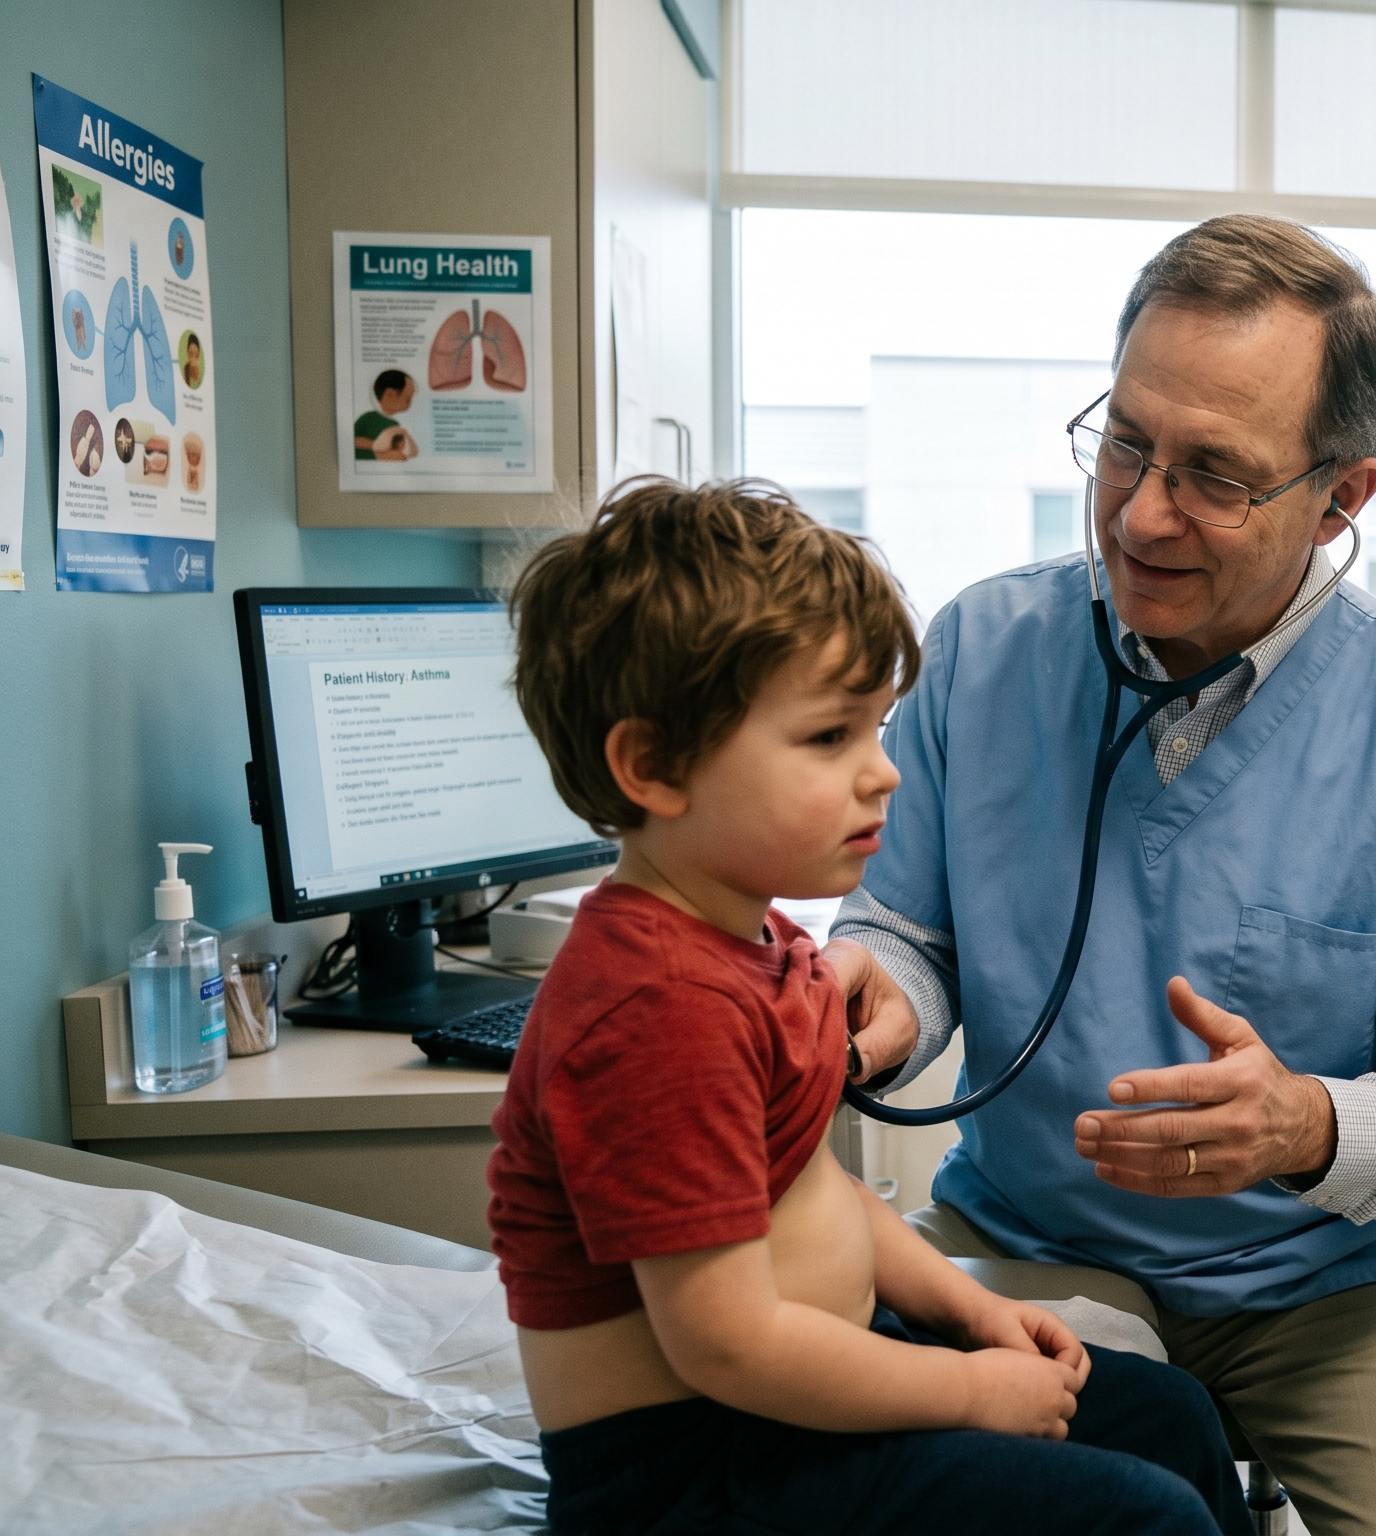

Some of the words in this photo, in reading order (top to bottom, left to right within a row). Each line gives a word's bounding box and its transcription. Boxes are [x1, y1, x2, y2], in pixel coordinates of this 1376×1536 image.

[78, 113, 176, 191] Allergies
[363, 252, 428, 280] Lung
[436, 253, 518, 278] Health
[324, 672, 363, 686] Patient
[411, 669, 450, 681] Asthma
